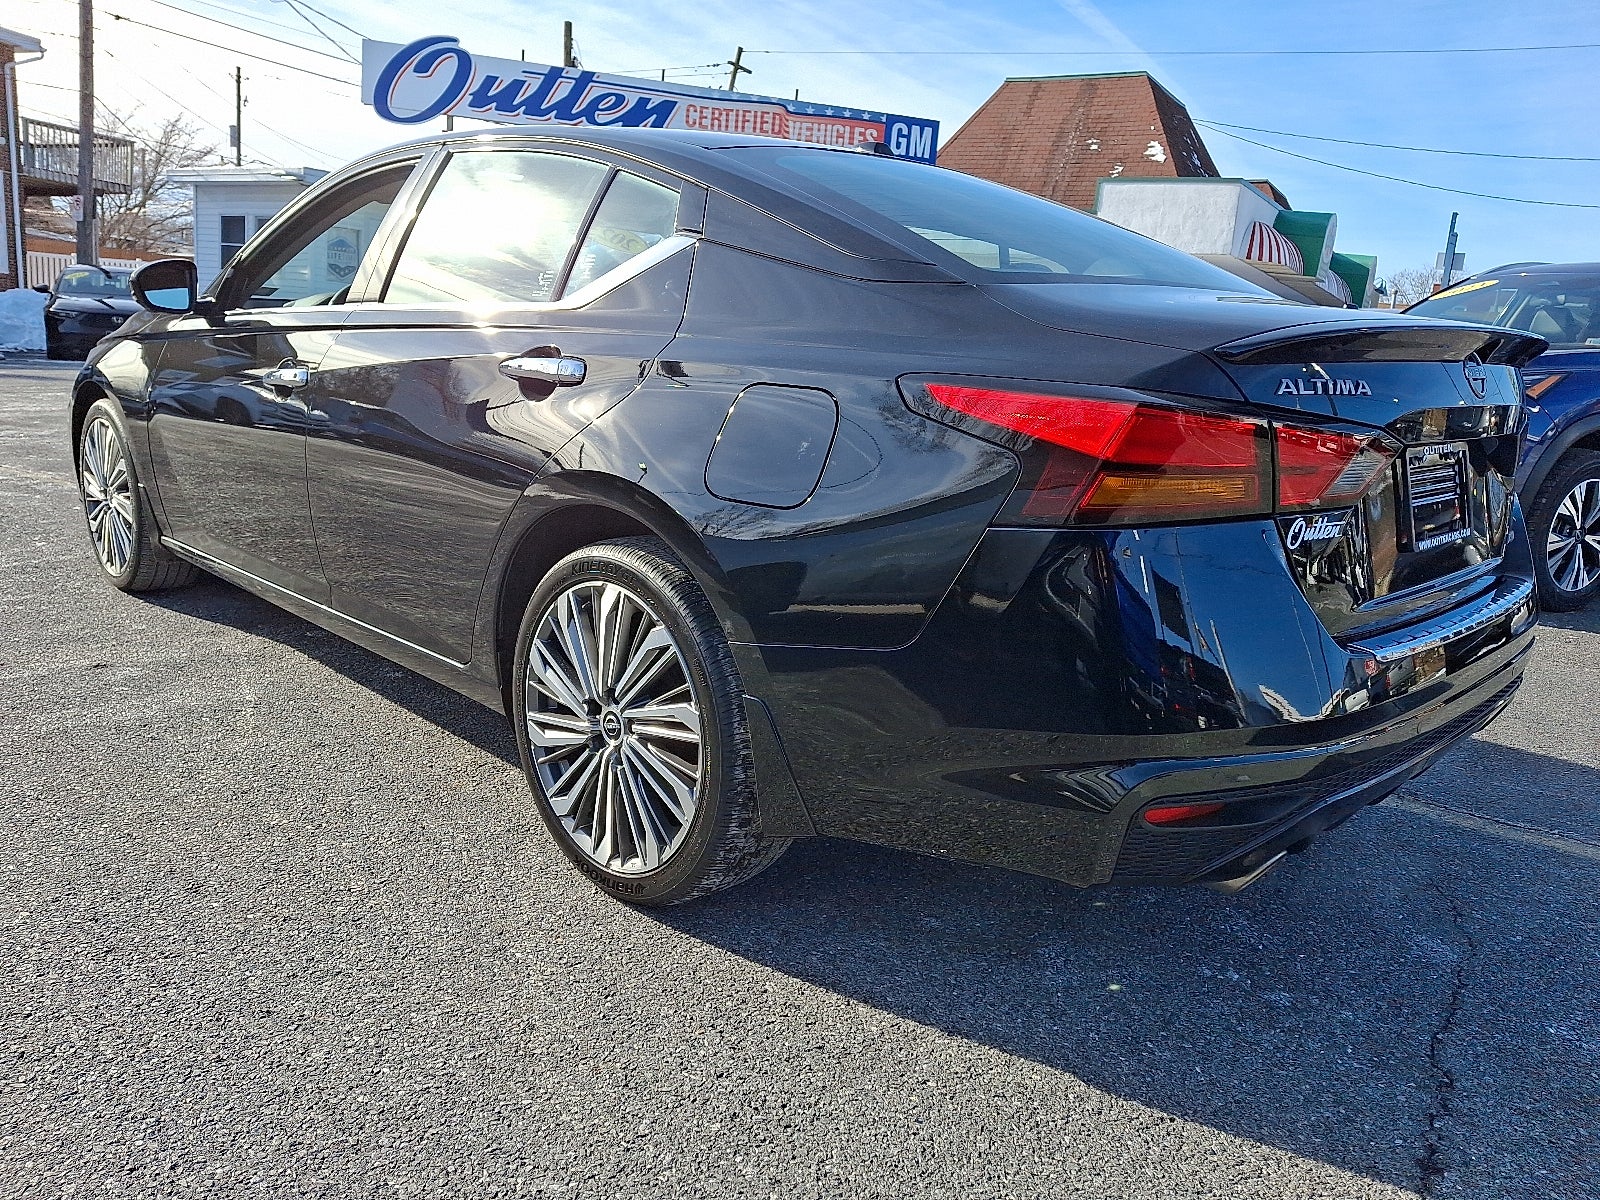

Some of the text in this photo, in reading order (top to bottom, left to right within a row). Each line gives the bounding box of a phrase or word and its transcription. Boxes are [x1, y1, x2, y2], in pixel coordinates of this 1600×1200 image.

[373, 36, 678, 128] Outten
[684, 104, 878, 148] CERTIFIED VEHICLES
[890, 123, 933, 159] GM
[1277, 378, 1372, 396] ALTIMA
[1423, 443, 1453, 455] OUTTEN
[1286, 517, 1346, 550] Outten
[1418, 528, 1471, 551] WWW.OUTTENCARS.COM
